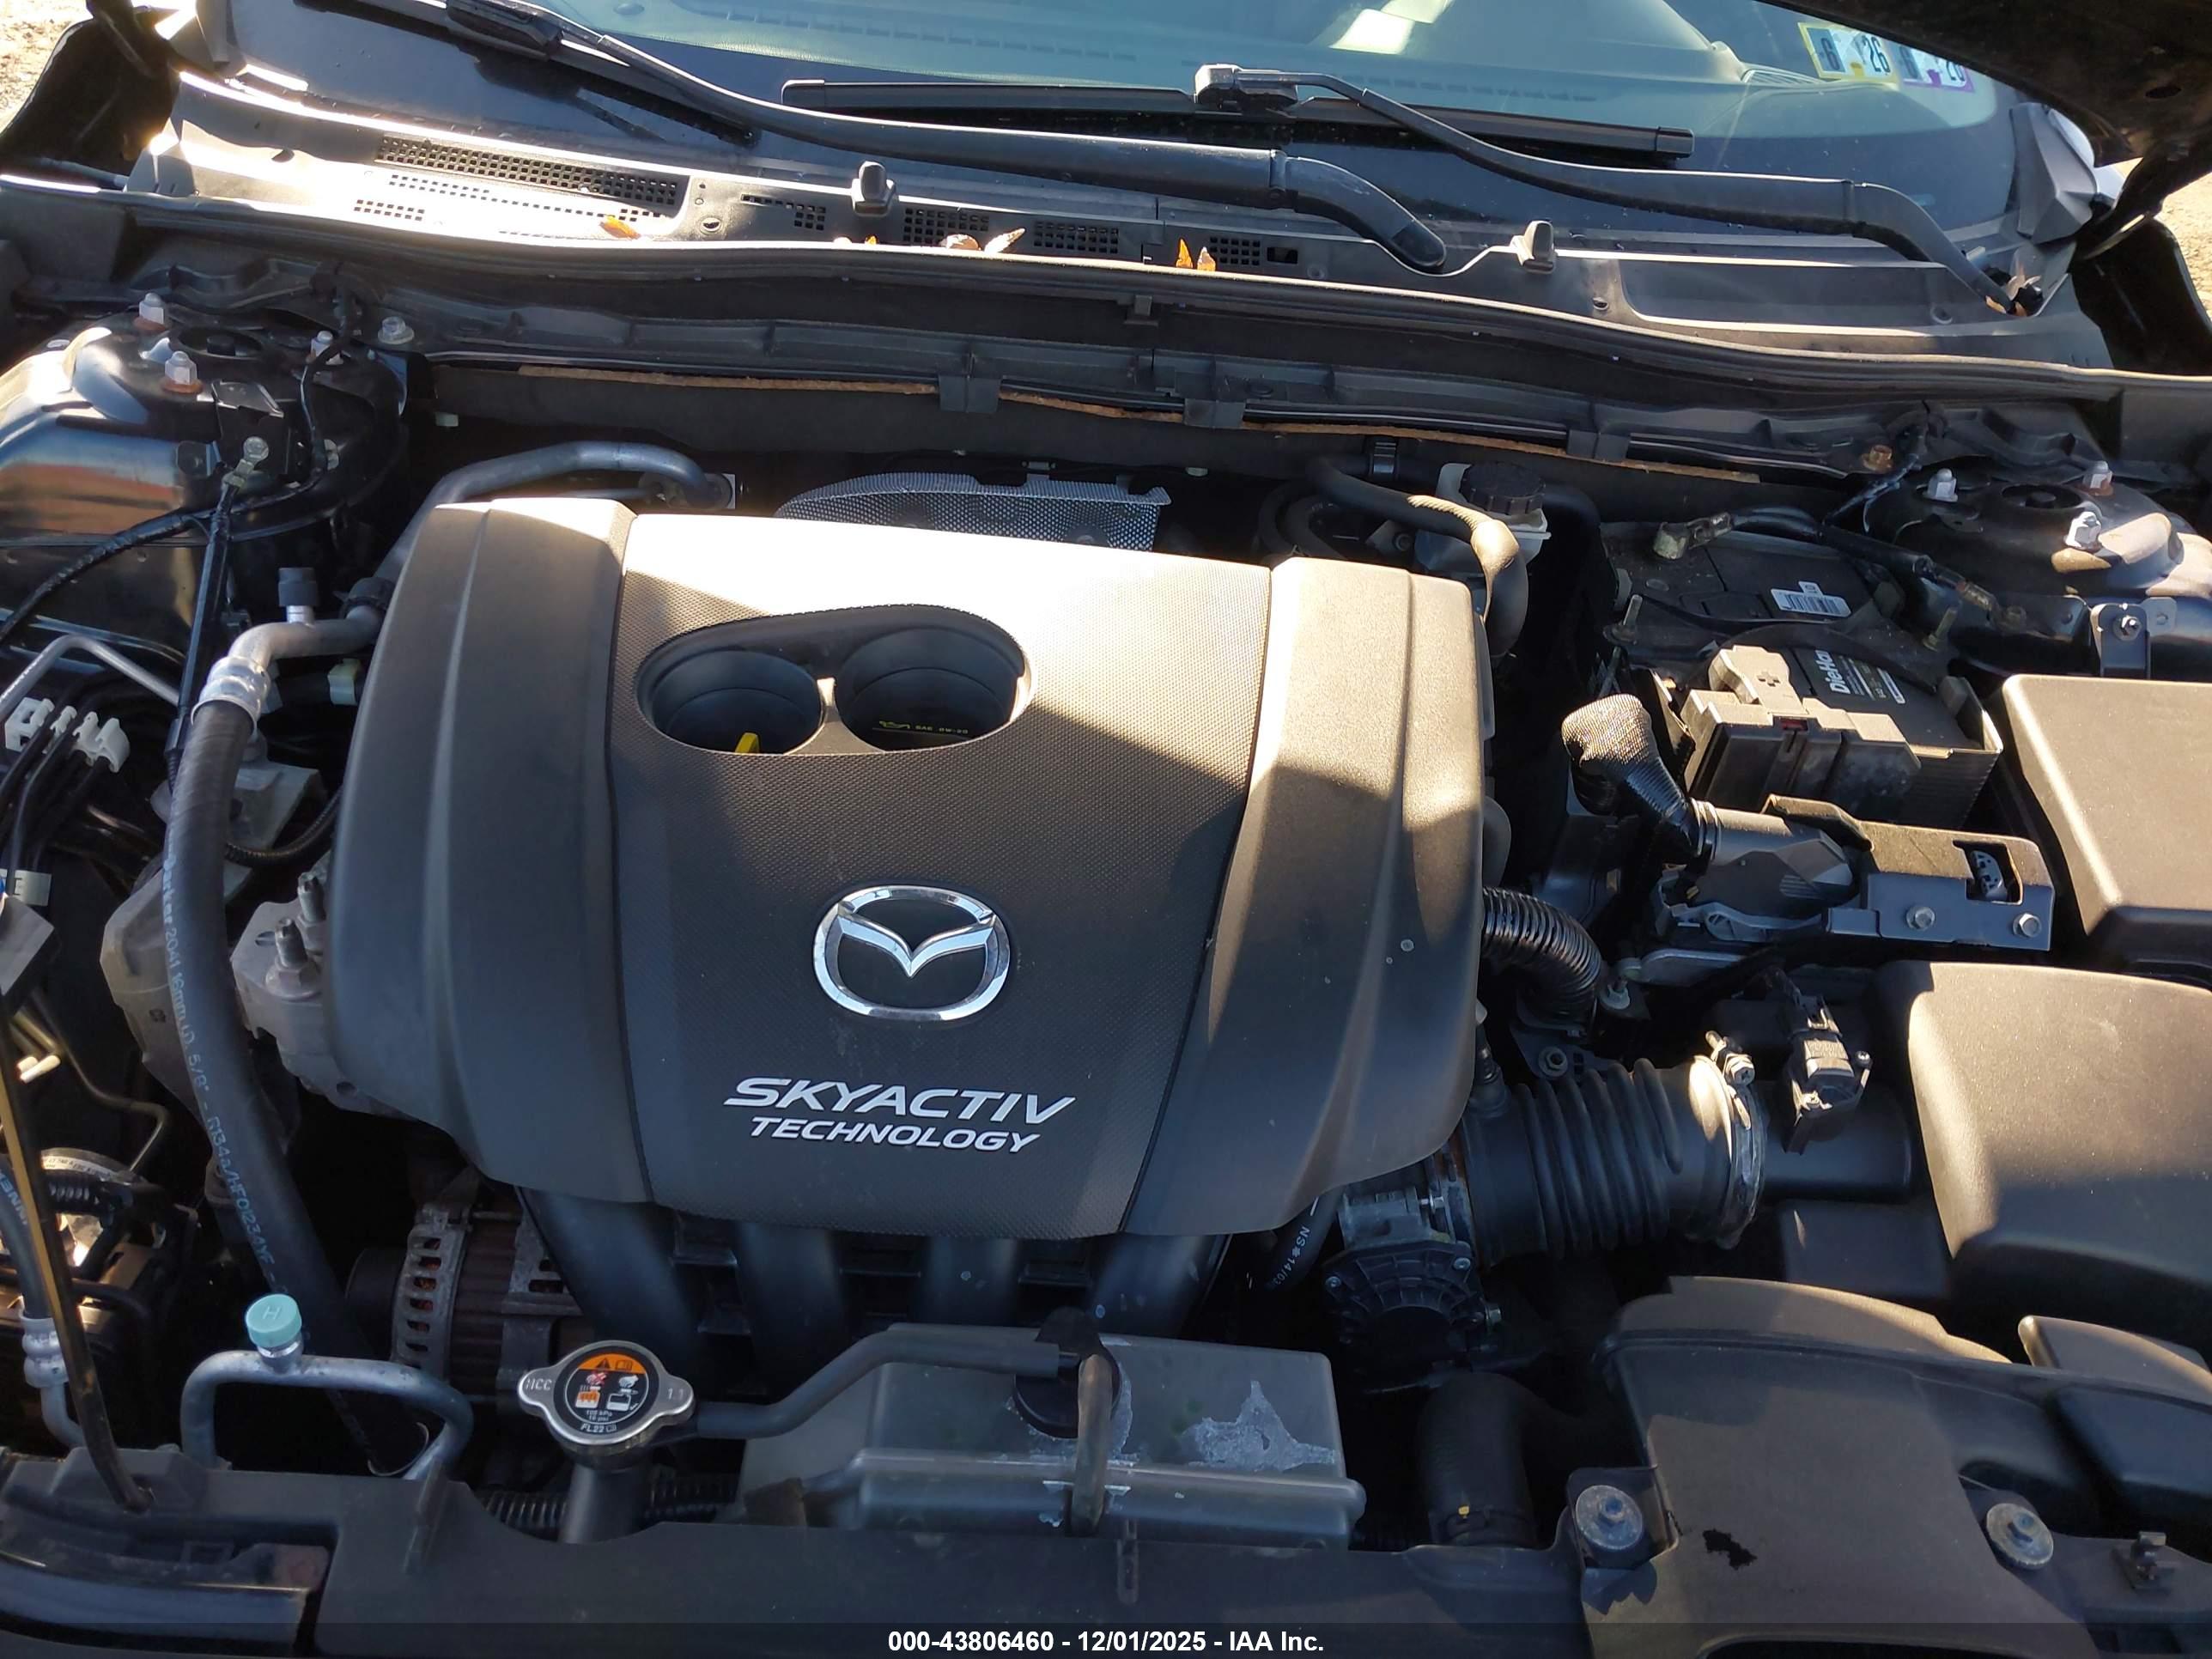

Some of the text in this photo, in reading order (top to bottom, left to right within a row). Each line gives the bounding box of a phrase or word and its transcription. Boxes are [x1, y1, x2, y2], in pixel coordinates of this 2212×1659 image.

[1862, 35, 1891, 72] 26
[724, 1077, 1076, 1124] SKYACTIV
[750, 1116, 1040, 1153] TECHNOLOGY
[262, 1306, 282, 1320] H
[580, 1423, 605, 1433] FL22
